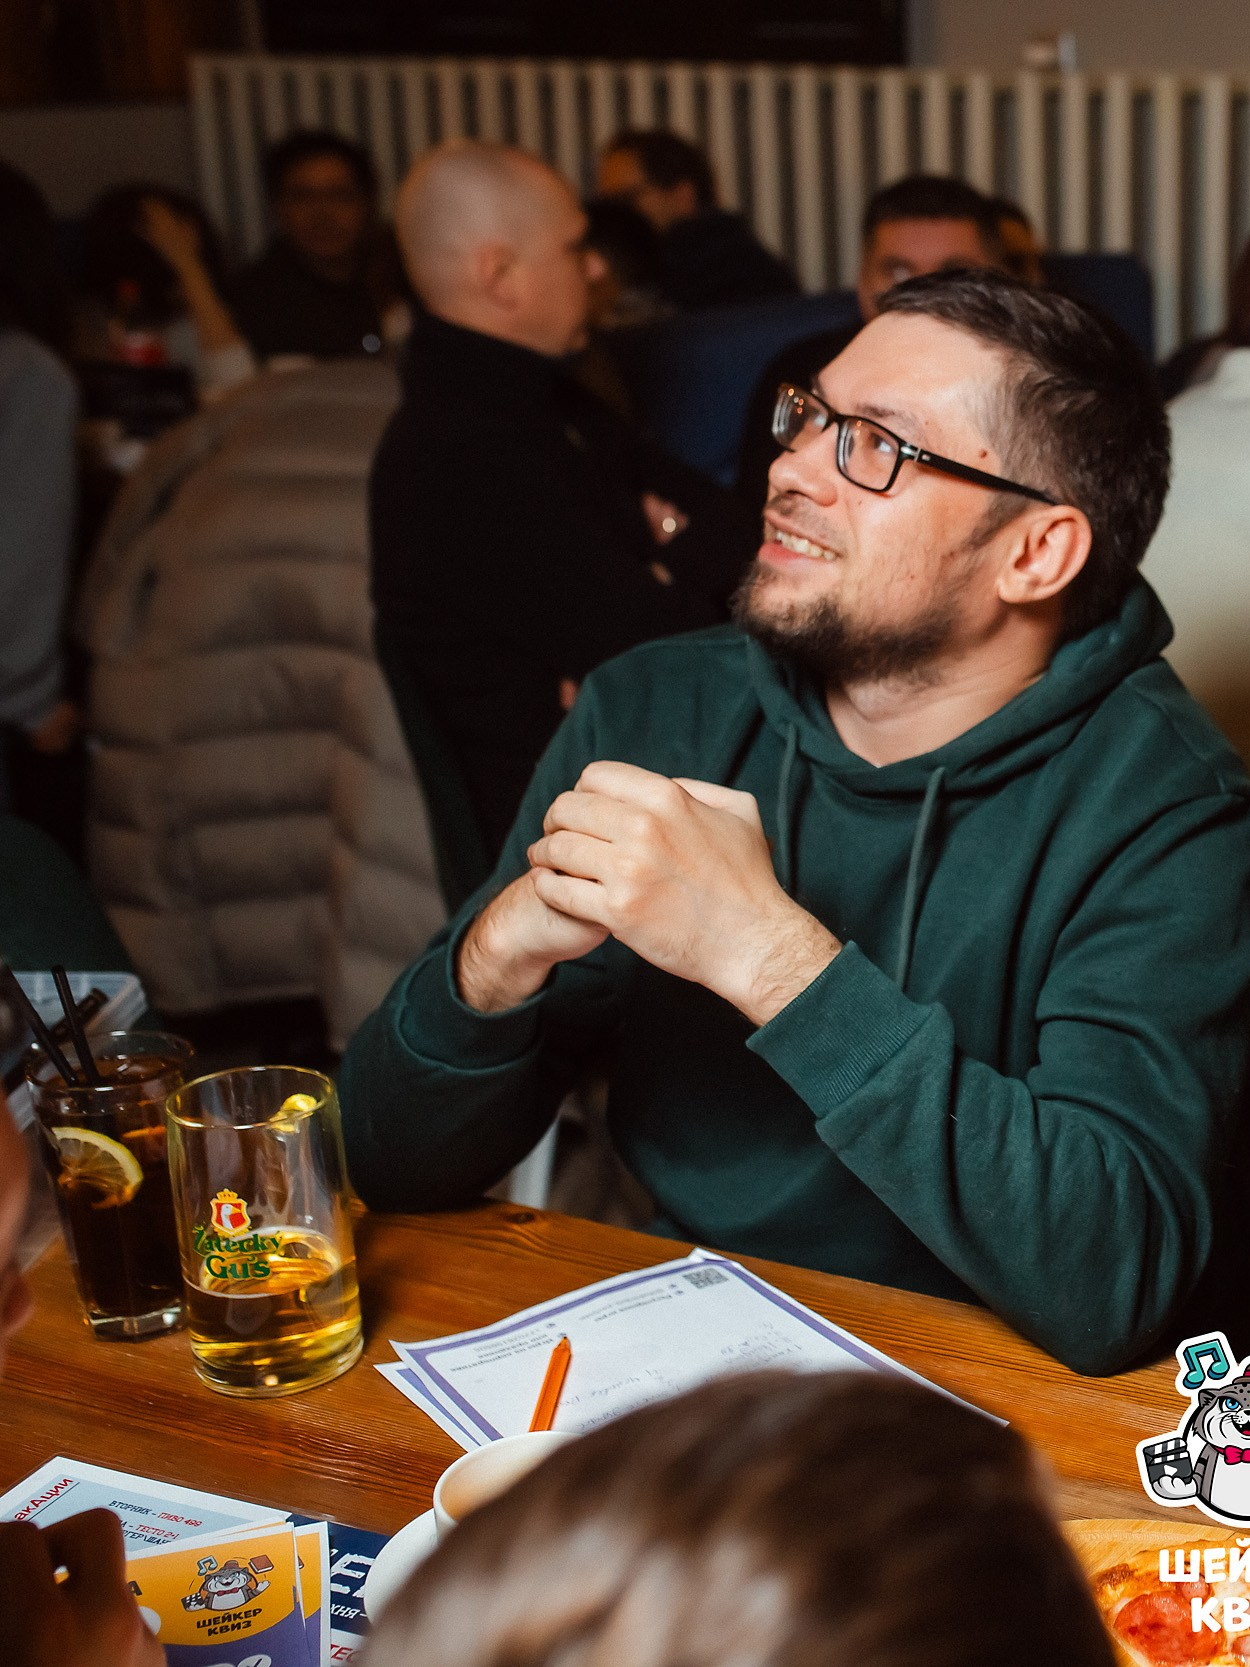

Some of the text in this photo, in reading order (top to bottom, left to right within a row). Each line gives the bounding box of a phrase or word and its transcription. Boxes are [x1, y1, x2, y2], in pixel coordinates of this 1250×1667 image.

[206, 1254, 271, 1280] Gus
[108, 1500, 152, 1516] ВТОРНИК
[157, 1512, 184, 1523] ПИВО
[135, 1524, 164, 1536] ТЕСТО
[196, 1608, 263, 1629] ШЕЙКЕР
[207, 1620, 252, 1637] КВИЗ
